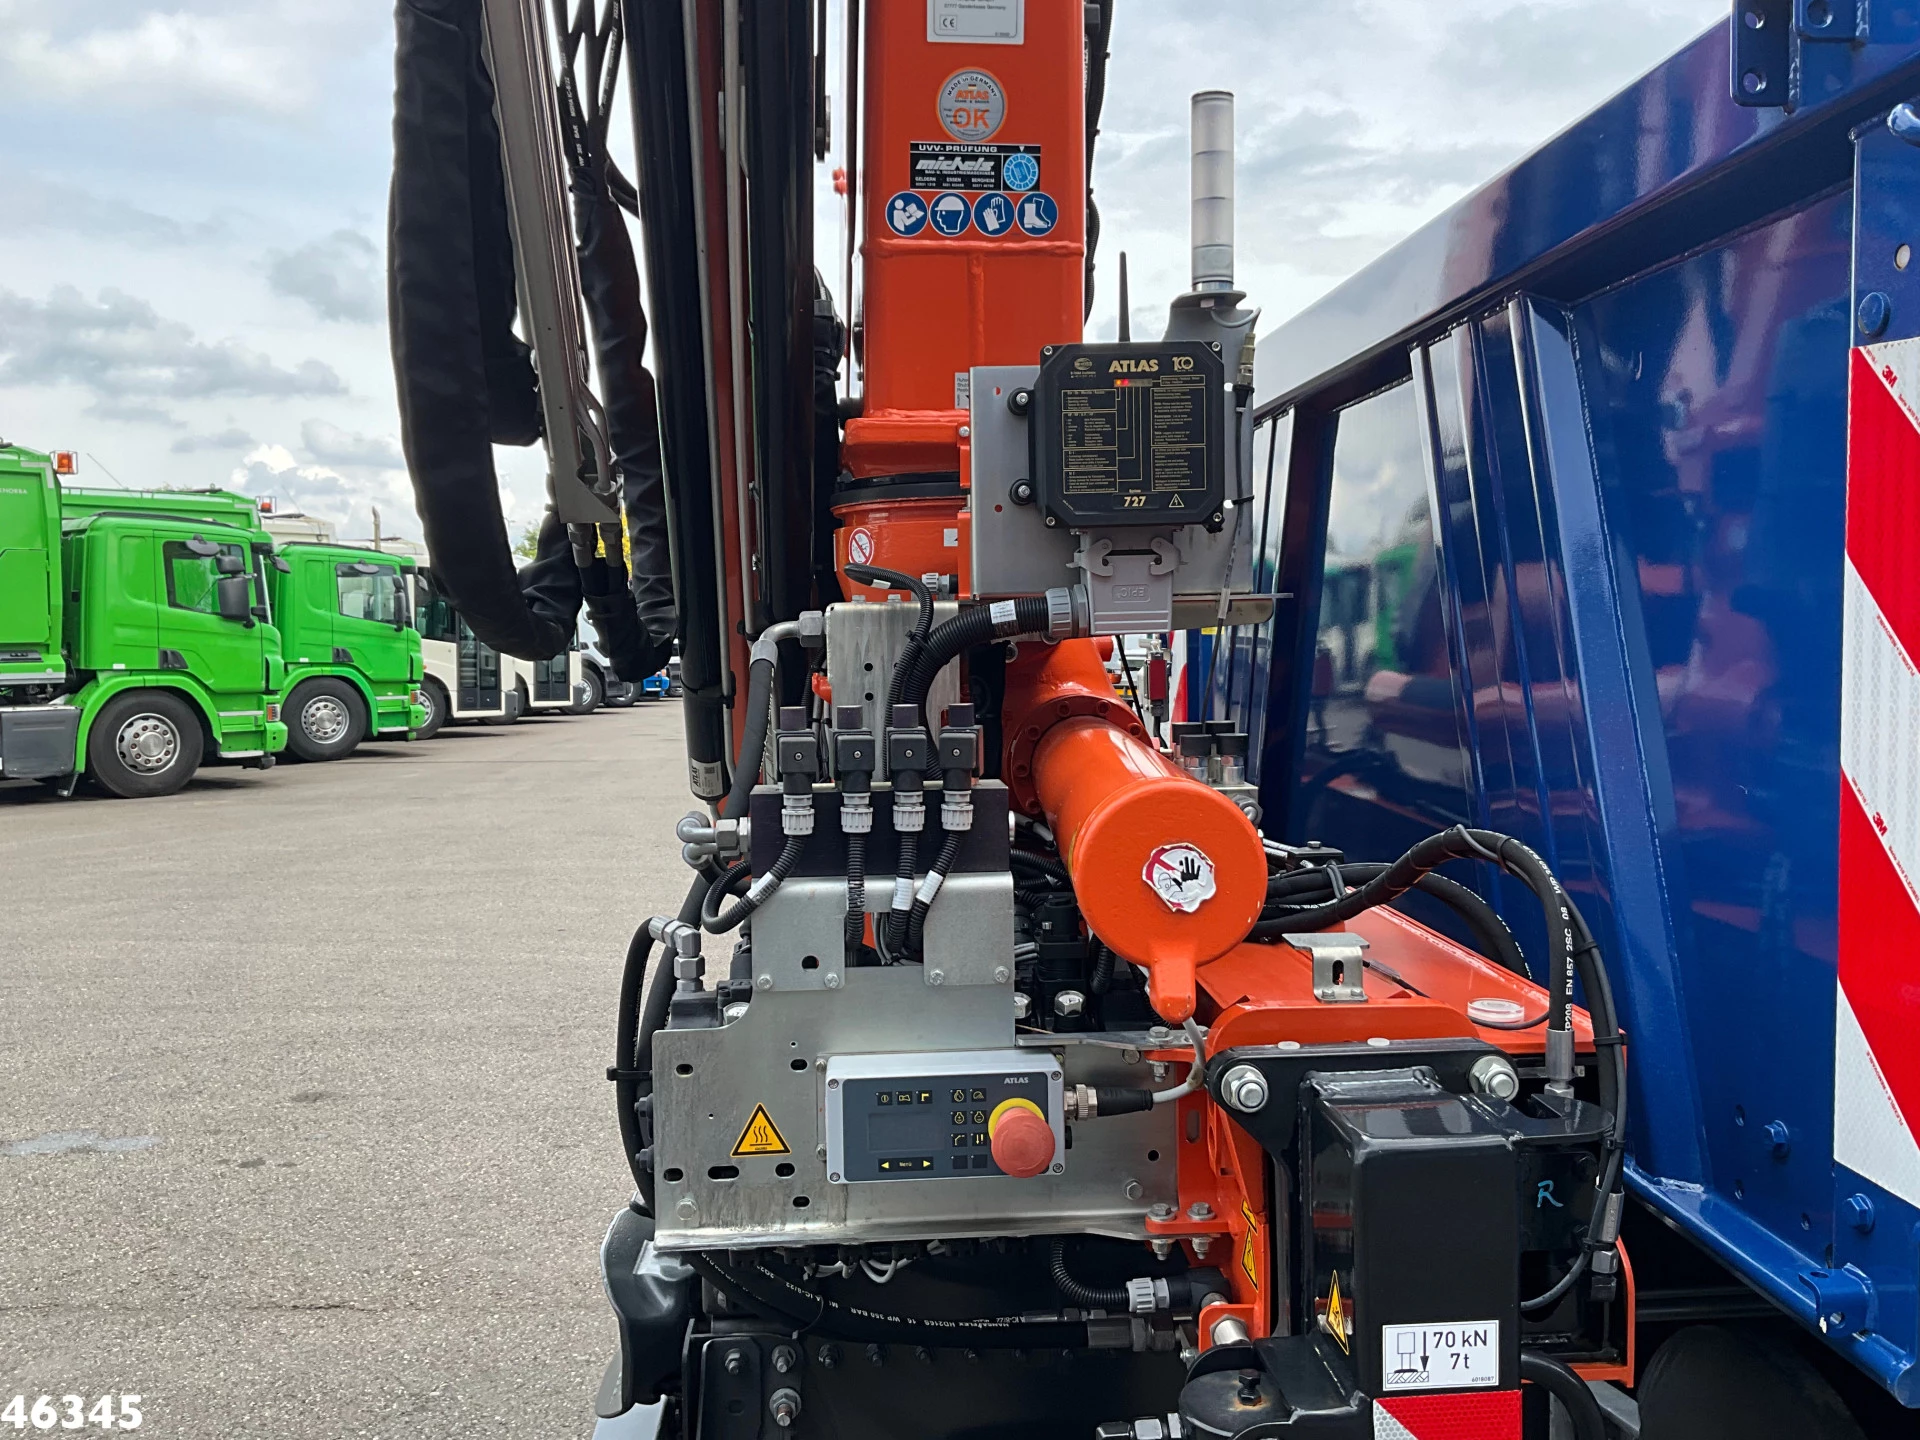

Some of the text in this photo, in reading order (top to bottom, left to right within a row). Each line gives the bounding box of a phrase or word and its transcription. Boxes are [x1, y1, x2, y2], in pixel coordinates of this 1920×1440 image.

[942, 18, 955, 28] CE
[947, 80, 962, 97] MADE
[970, 75, 998, 97] GERMANY
[955, 89, 990, 100] ATLAS
[953, 107, 990, 129] OK
[945, 144, 998, 153] PRÜFUNG
[1108, 359, 1159, 373] ATLAS
[1882, 364, 1898, 388] 3M
[1123, 496, 1147, 508] 727
[692, 766, 700, 787] ATLAS
[1872, 811, 1888, 836] 3M
[1560, 906, 1570, 920] 08
[1564, 927, 1573, 951] 2SC
[1566, 956, 1574, 977] 857
[1566, 979, 1573, 995] EN
[1004, 1076, 1029, 1085] ATLAS
[1536, 1180, 1564, 1208] R
[850, 1306, 868, 1317] BAR
[887, 1315, 901, 1323] WP
[1433, 1329, 1488, 1349] 70 kN
